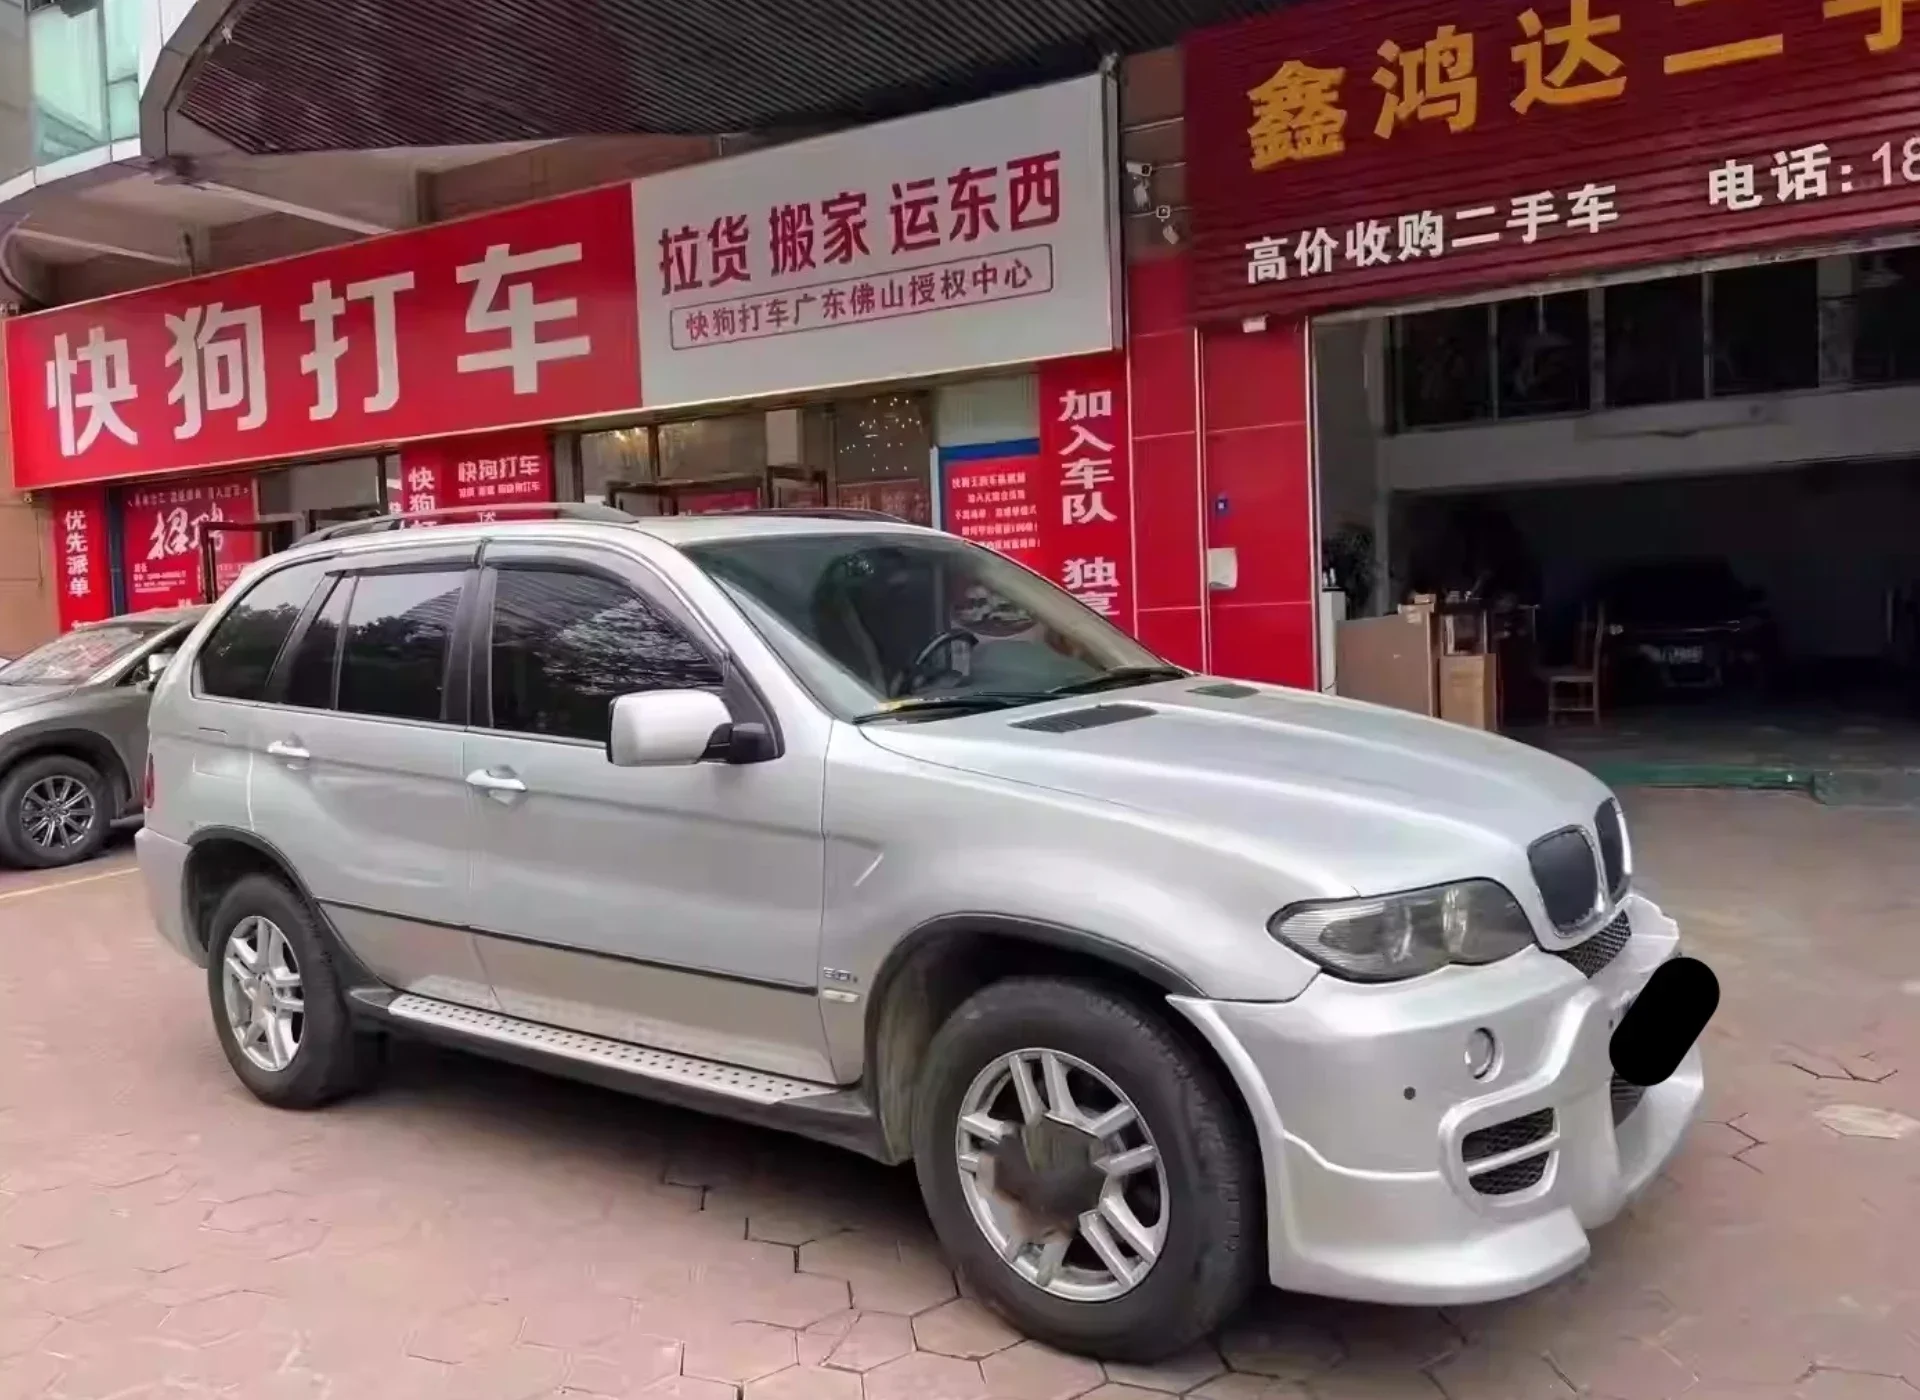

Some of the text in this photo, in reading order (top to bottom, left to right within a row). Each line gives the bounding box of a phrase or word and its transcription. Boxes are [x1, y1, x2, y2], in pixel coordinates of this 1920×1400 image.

[658, 151, 1061, 296] 拉货 搬家 运东西
[1245, 183, 1619, 284] 高价收购二手车
[46, 242, 591, 457] 快狗打车
[685, 257, 1033, 342] 快狗打车广东佛山授权中心
[457, 454, 541, 484] 快狗打车
[1058, 389, 1118, 526] 加入车队
[64, 509, 90, 598] 优先派单
